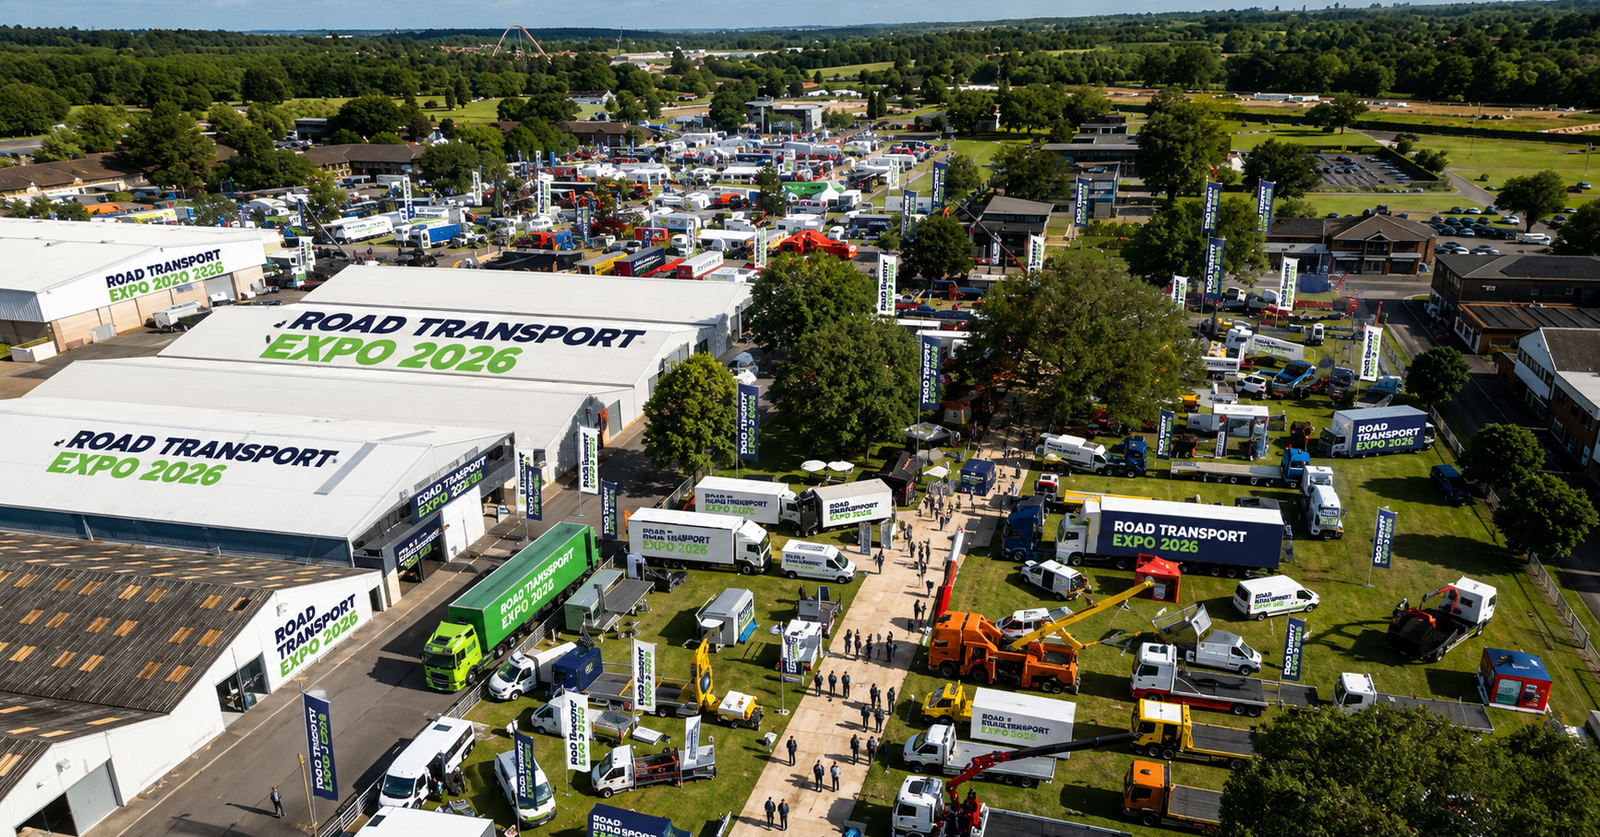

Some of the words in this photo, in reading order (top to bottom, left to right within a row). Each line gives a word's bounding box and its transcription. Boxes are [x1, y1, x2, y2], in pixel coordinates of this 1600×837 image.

[105, 268, 145, 288] ROAD
[146, 249, 222, 274] TRANSPORT
[109, 281, 150, 302] EXPO
[152, 270, 189, 291] 2020
[287, 310, 407, 334] ROAD
[412, 317, 647, 348] TRANSPORT
[259, 333, 397, 366] EXPO
[397, 341, 524, 374] 2026
[1356, 427, 1421, 443] TRANSPORT
[1356, 438, 1386, 451] EXPO
[1387, 436, 1415, 448] 2026
[1358, 422, 1389, 434] ROAD
[65, 430, 156, 453] ROAD
[159, 437, 339, 467] TRANSPORT
[46, 452, 140, 479] EXPO
[138, 460, 228, 486] 2026
[418, 491, 449, 518] EXPO
[643, 540, 675, 552] EXPO
[1112, 533, 1156, 549] EXPO
[1159, 538, 1199, 553] 2026
[1113, 520, 1155, 535] ROAD
[1159, 524, 1247, 543] TRANSPORT
[500, 588, 524, 615] ROAD
[274, 605, 316, 645] ROAD
[276, 593, 356, 660] TRANSPORT
[280, 637, 320, 678] EXPO
[323, 609, 359, 647] 2026
